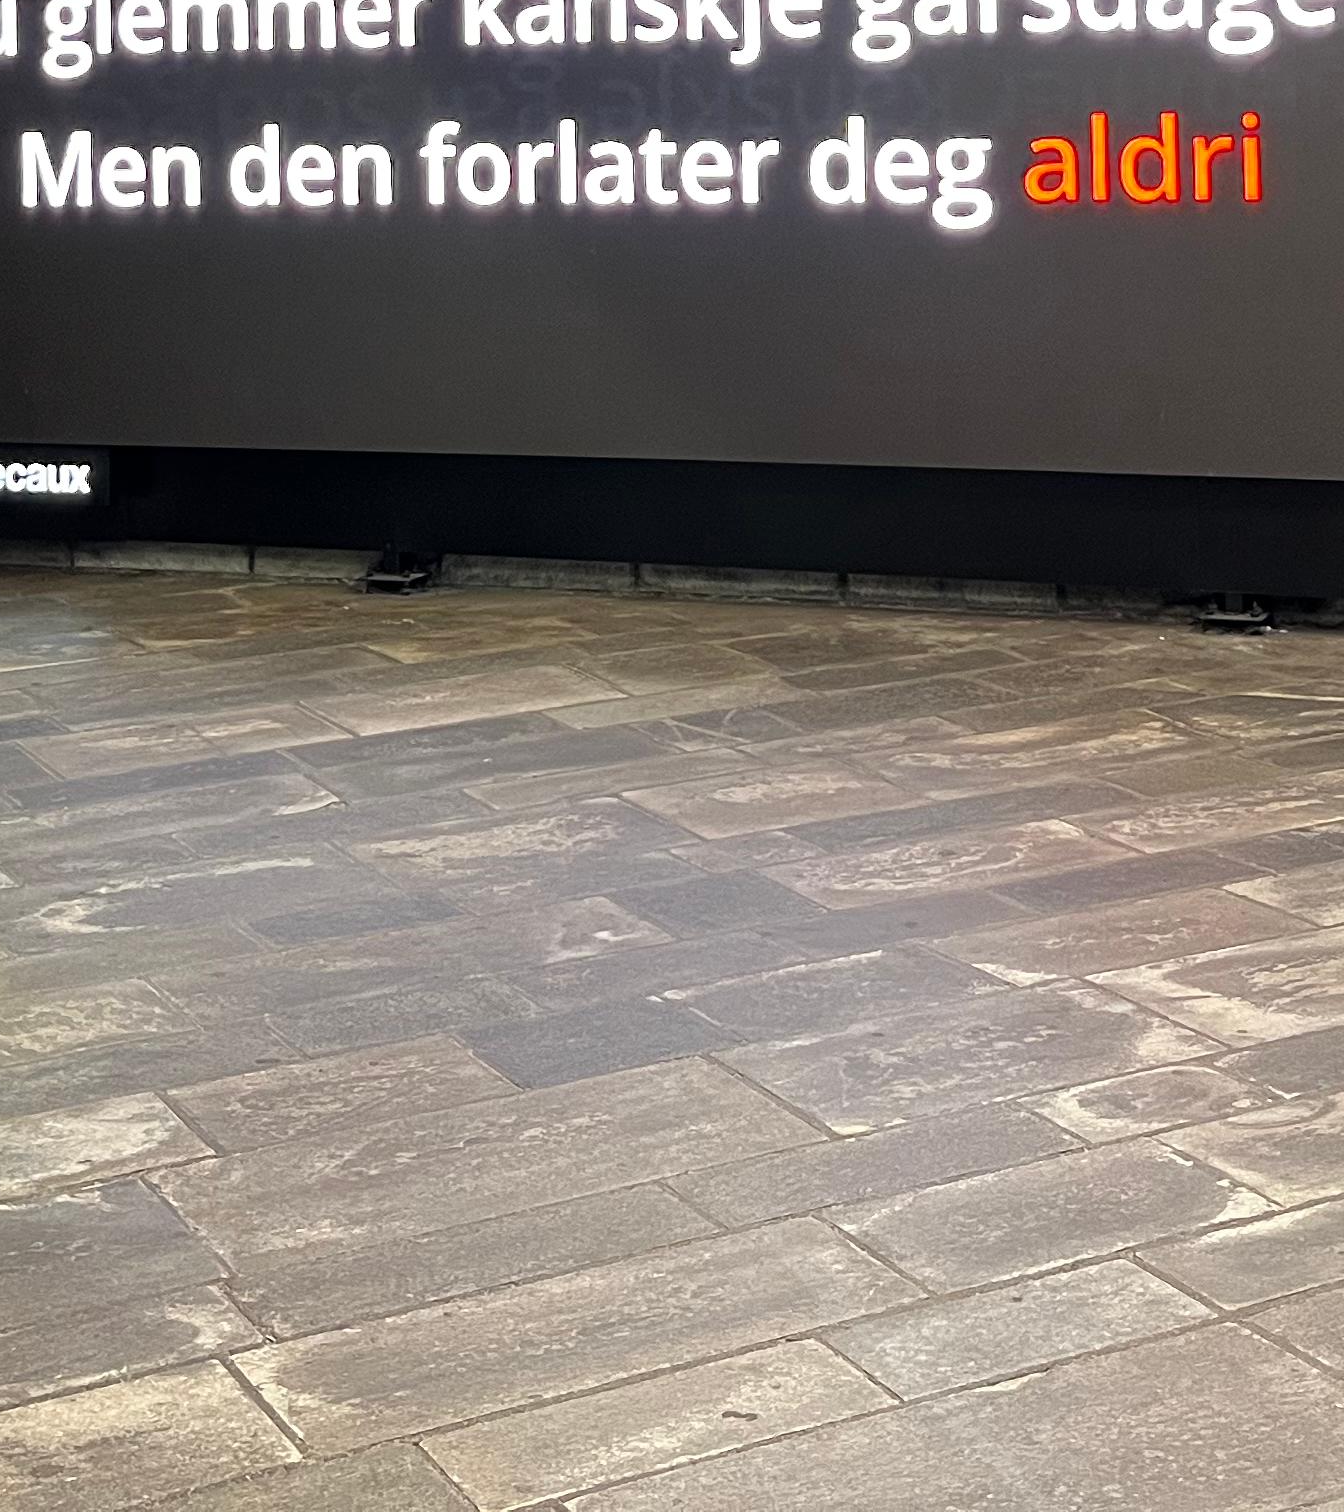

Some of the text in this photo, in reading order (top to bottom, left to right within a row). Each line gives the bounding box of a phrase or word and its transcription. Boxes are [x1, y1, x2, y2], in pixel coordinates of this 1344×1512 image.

[20, 111, 1262, 230] Men den forlater deg aldri
